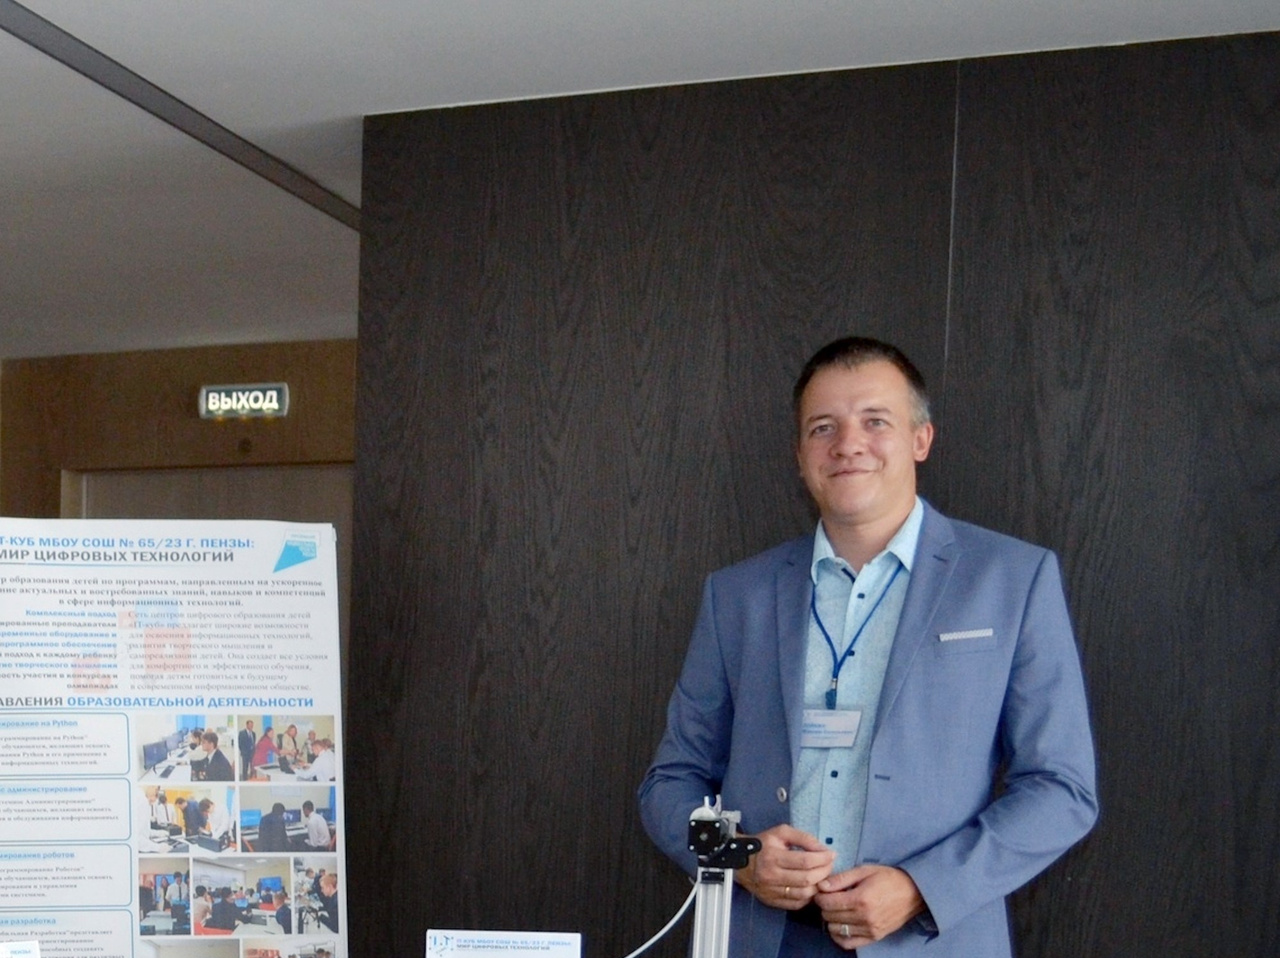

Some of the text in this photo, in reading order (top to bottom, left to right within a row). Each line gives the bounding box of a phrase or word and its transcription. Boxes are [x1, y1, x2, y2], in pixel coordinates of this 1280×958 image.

[208, 390, 279, 410] ВЫХОД
[38, 537, 78, 547] МБОУ
[81, 537, 115, 547] СОШ
[119, 538, 134, 547] №
[137, 537, 182, 549] 65/23
[185, 538, 195, 548] Г.
[200, 538, 254, 548] ПЕНЗЫ:
[34, 550, 127, 562] ЦИФРОВЫХ
[131, 550, 233, 562] ТЕХНОЛОГИЙ
[67, 696, 204, 709] ОБРАЗОВАТЕЛЬНОЙ
[207, 697, 313, 708] ДЕЯТЕЛЬНОСТИ
